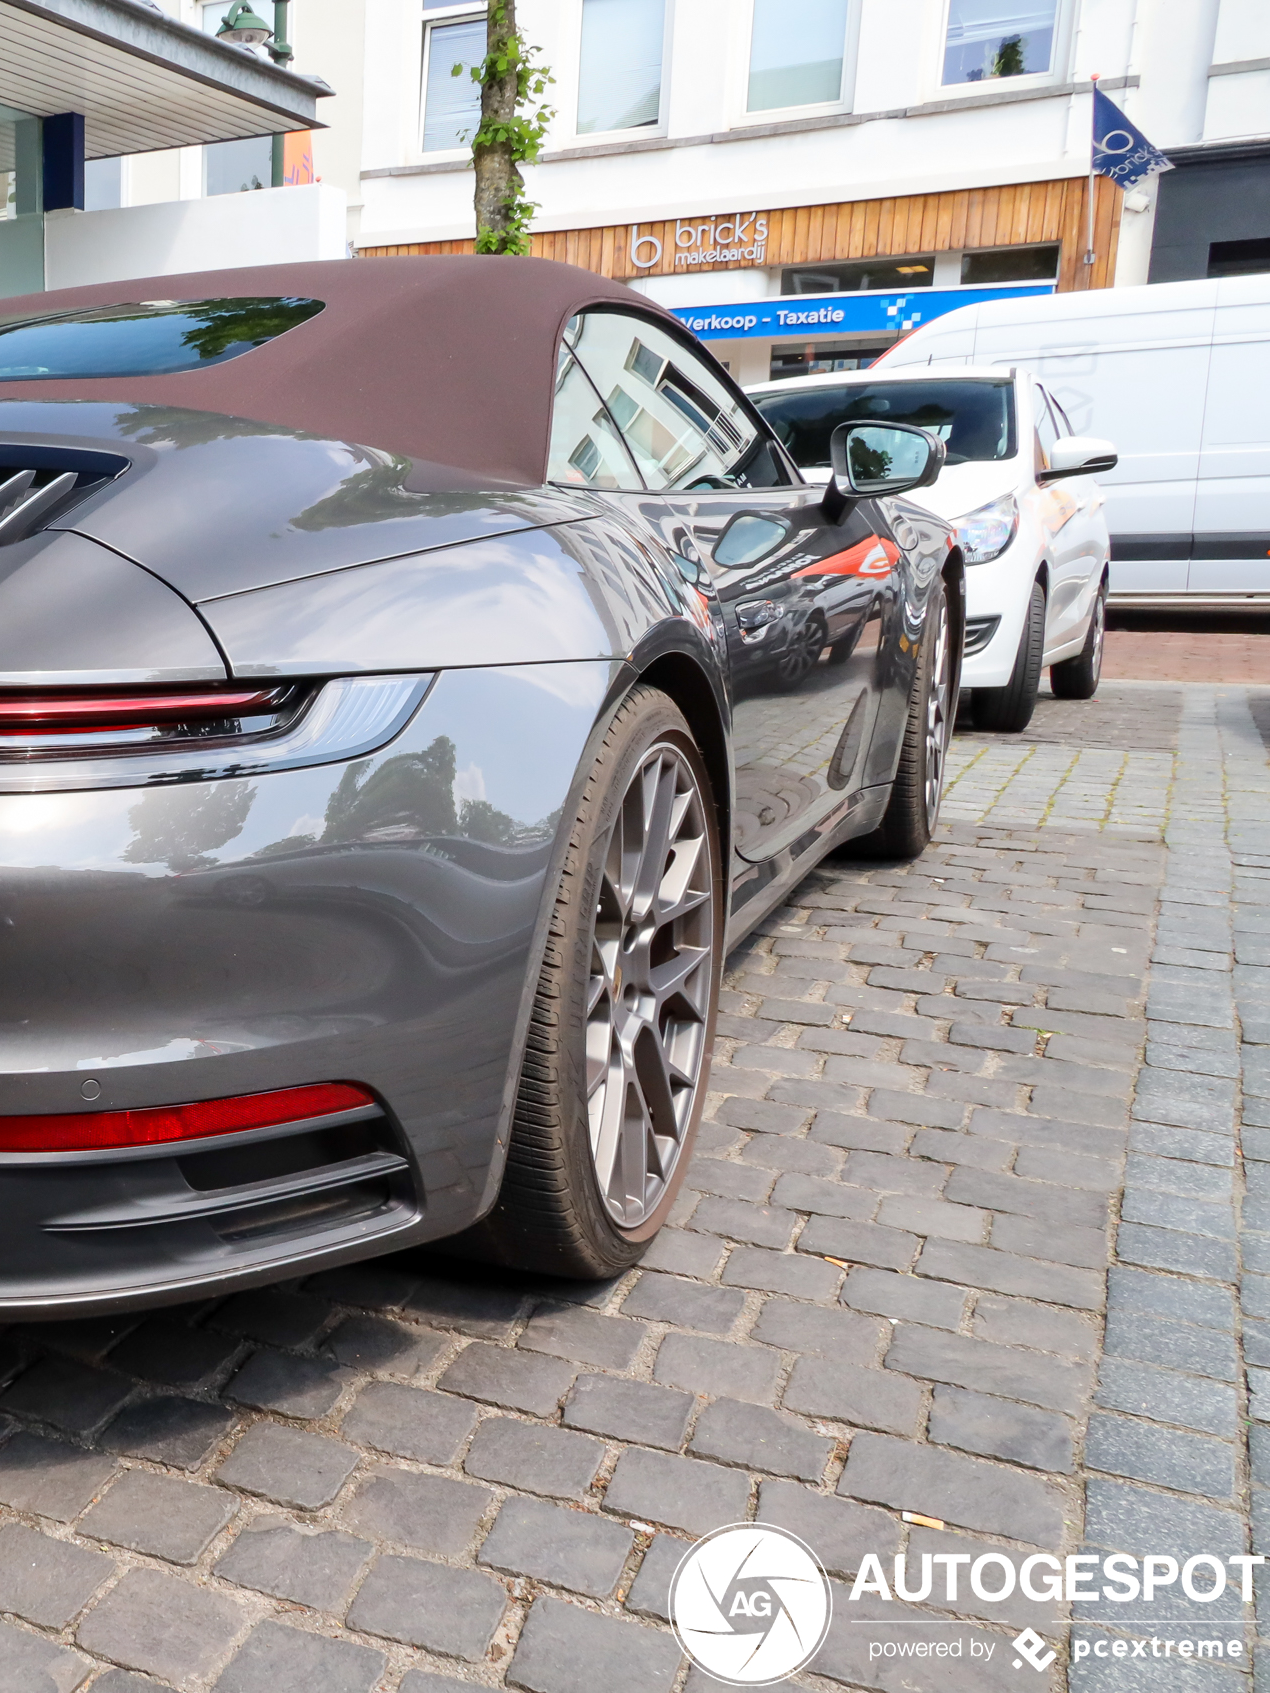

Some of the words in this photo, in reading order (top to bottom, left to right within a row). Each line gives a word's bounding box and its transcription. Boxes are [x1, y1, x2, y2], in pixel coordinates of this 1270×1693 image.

[675, 211, 768, 248] brick's
[675, 242, 766, 266] makelaardij
[680, 313, 757, 332] Verkoop
[776, 306, 845, 327] Taxatie
